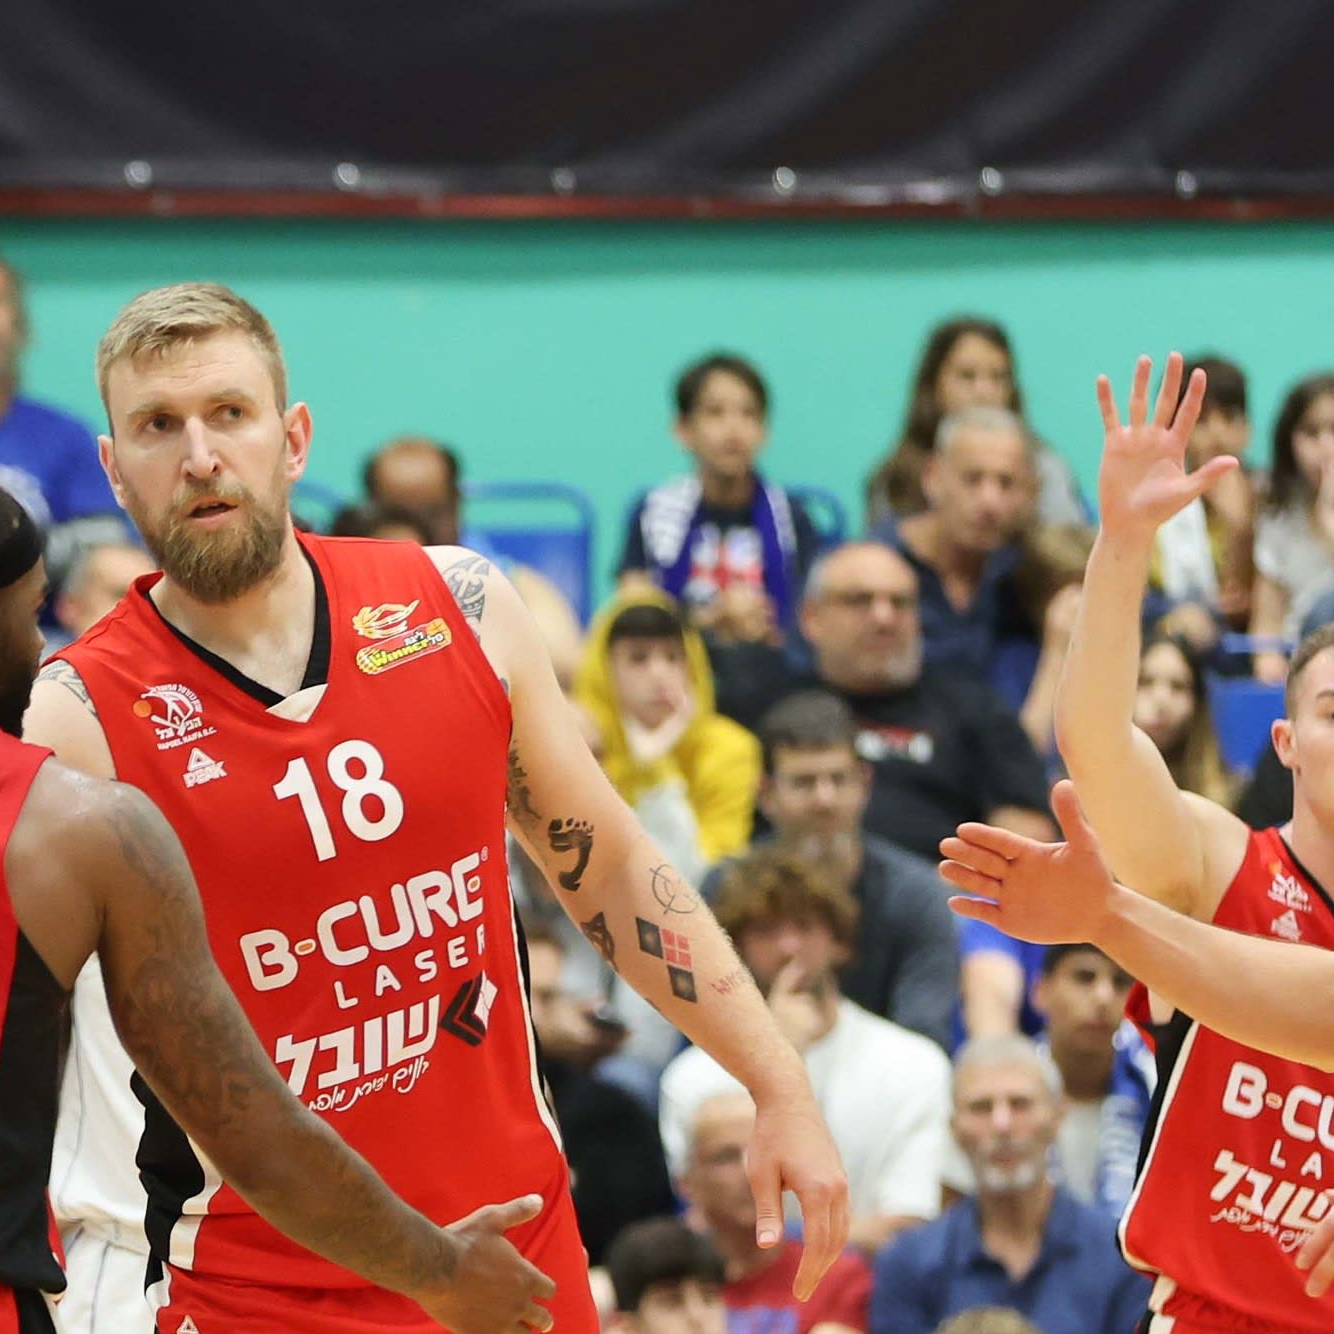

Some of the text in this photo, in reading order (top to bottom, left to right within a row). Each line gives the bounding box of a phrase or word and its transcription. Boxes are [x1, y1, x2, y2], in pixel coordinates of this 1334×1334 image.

[368, 639, 428, 668] Winner
[183, 761, 228, 788] PEAK
[273, 739, 405, 863] 18
[240, 852, 485, 992] B-CURE
[274, 993, 441, 1098] שובל
